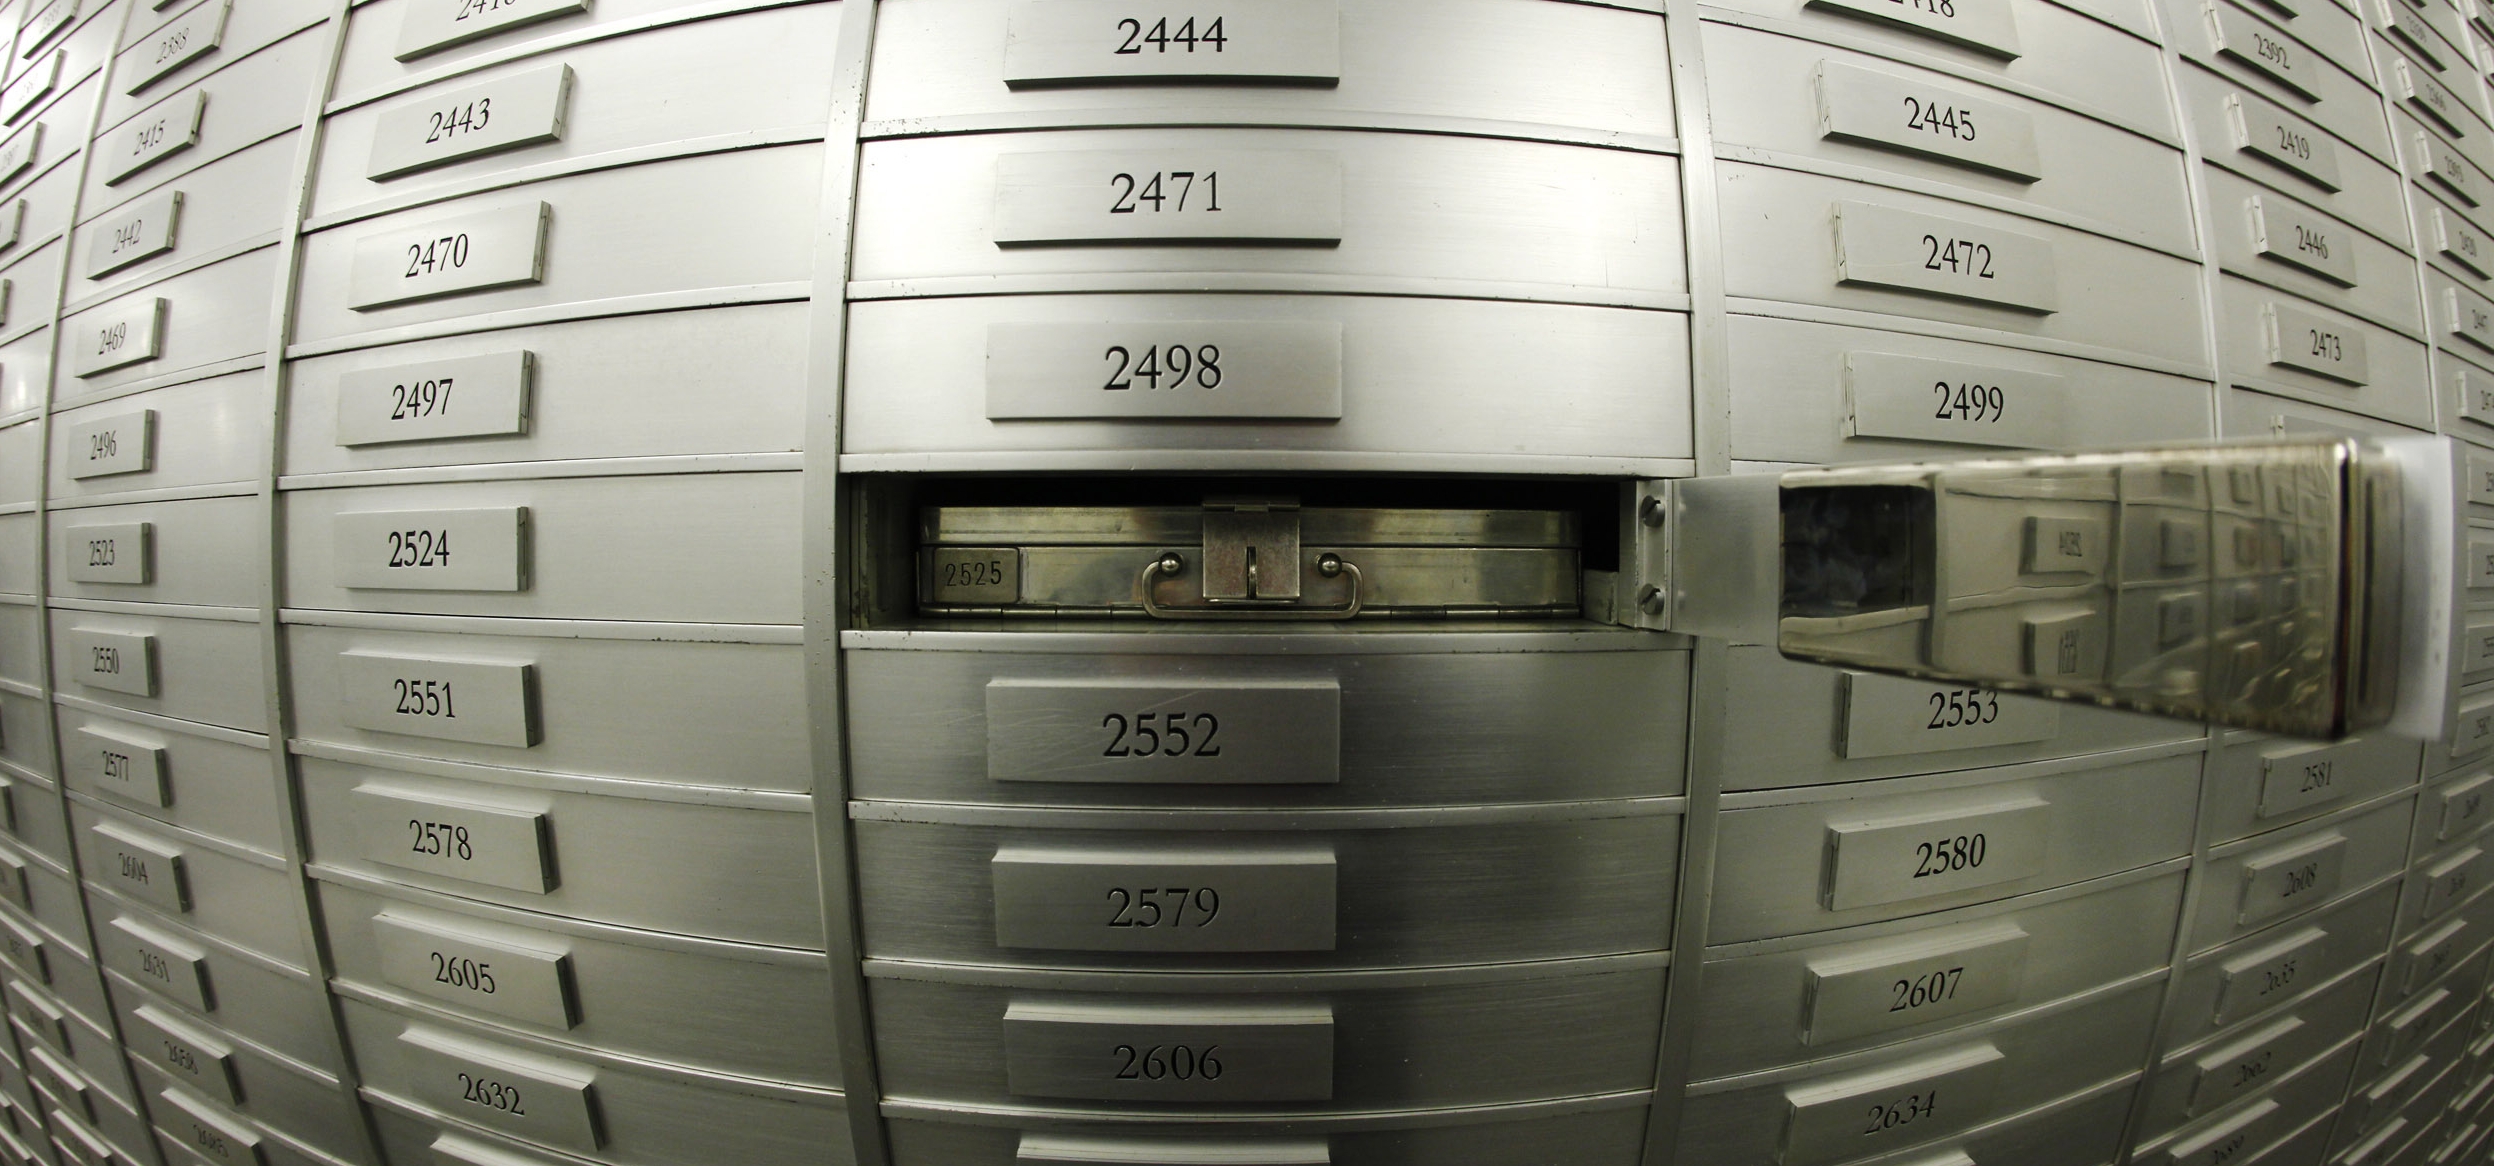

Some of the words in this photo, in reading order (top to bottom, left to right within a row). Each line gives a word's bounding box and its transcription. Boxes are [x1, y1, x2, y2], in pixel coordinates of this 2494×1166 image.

[1114, 16, 1228, 54] 2444
[2254, 33, 2291, 70] 2392
[133, 119, 165, 155] 2415
[425, 97, 491, 144] 2443
[1904, 96, 1976, 141] 2445
[2277, 126, 2310, 160] 2419
[1110, 171, 1222, 213] 2471
[112, 219, 142, 253] 2442
[405, 233, 469, 278] 2470
[2295, 225, 2328, 259] 2446
[1922, 234, 1994, 279] 2472
[98, 322, 126, 355] 2469
[2310, 329, 2342, 361] 2473
[1103, 344, 1222, 391] 2498
[391, 378, 454, 420] 2497
[1934, 380, 2004, 423] 2499
[90, 430, 117, 460] 2496
[89, 539, 115, 566] 2523
[388, 529, 450, 567] 2524
[945, 561, 1002, 587] 2525
[93, 647, 119, 674] 2550
[393, 678, 456, 718] 2551
[1927, 689, 1999, 729] 2553
[1102, 712, 1221, 757] 2552
[102, 751, 129, 782] 2577
[2301, 761, 2333, 793] 2581
[408, 819, 472, 860] 2578
[1913, 833, 1986, 879] 2580
[118, 852, 148, 885] 2604
[1107, 887, 1220, 928] 2579
[139, 950, 170, 982] 2631
[431, 952, 495, 994] 2605
[1889, 966, 1964, 1013] 2607
[1113, 1044, 1223, 1081] 2606
[458, 1073, 525, 1116] 2632
[1863, 1090, 1937, 1137] 2634
